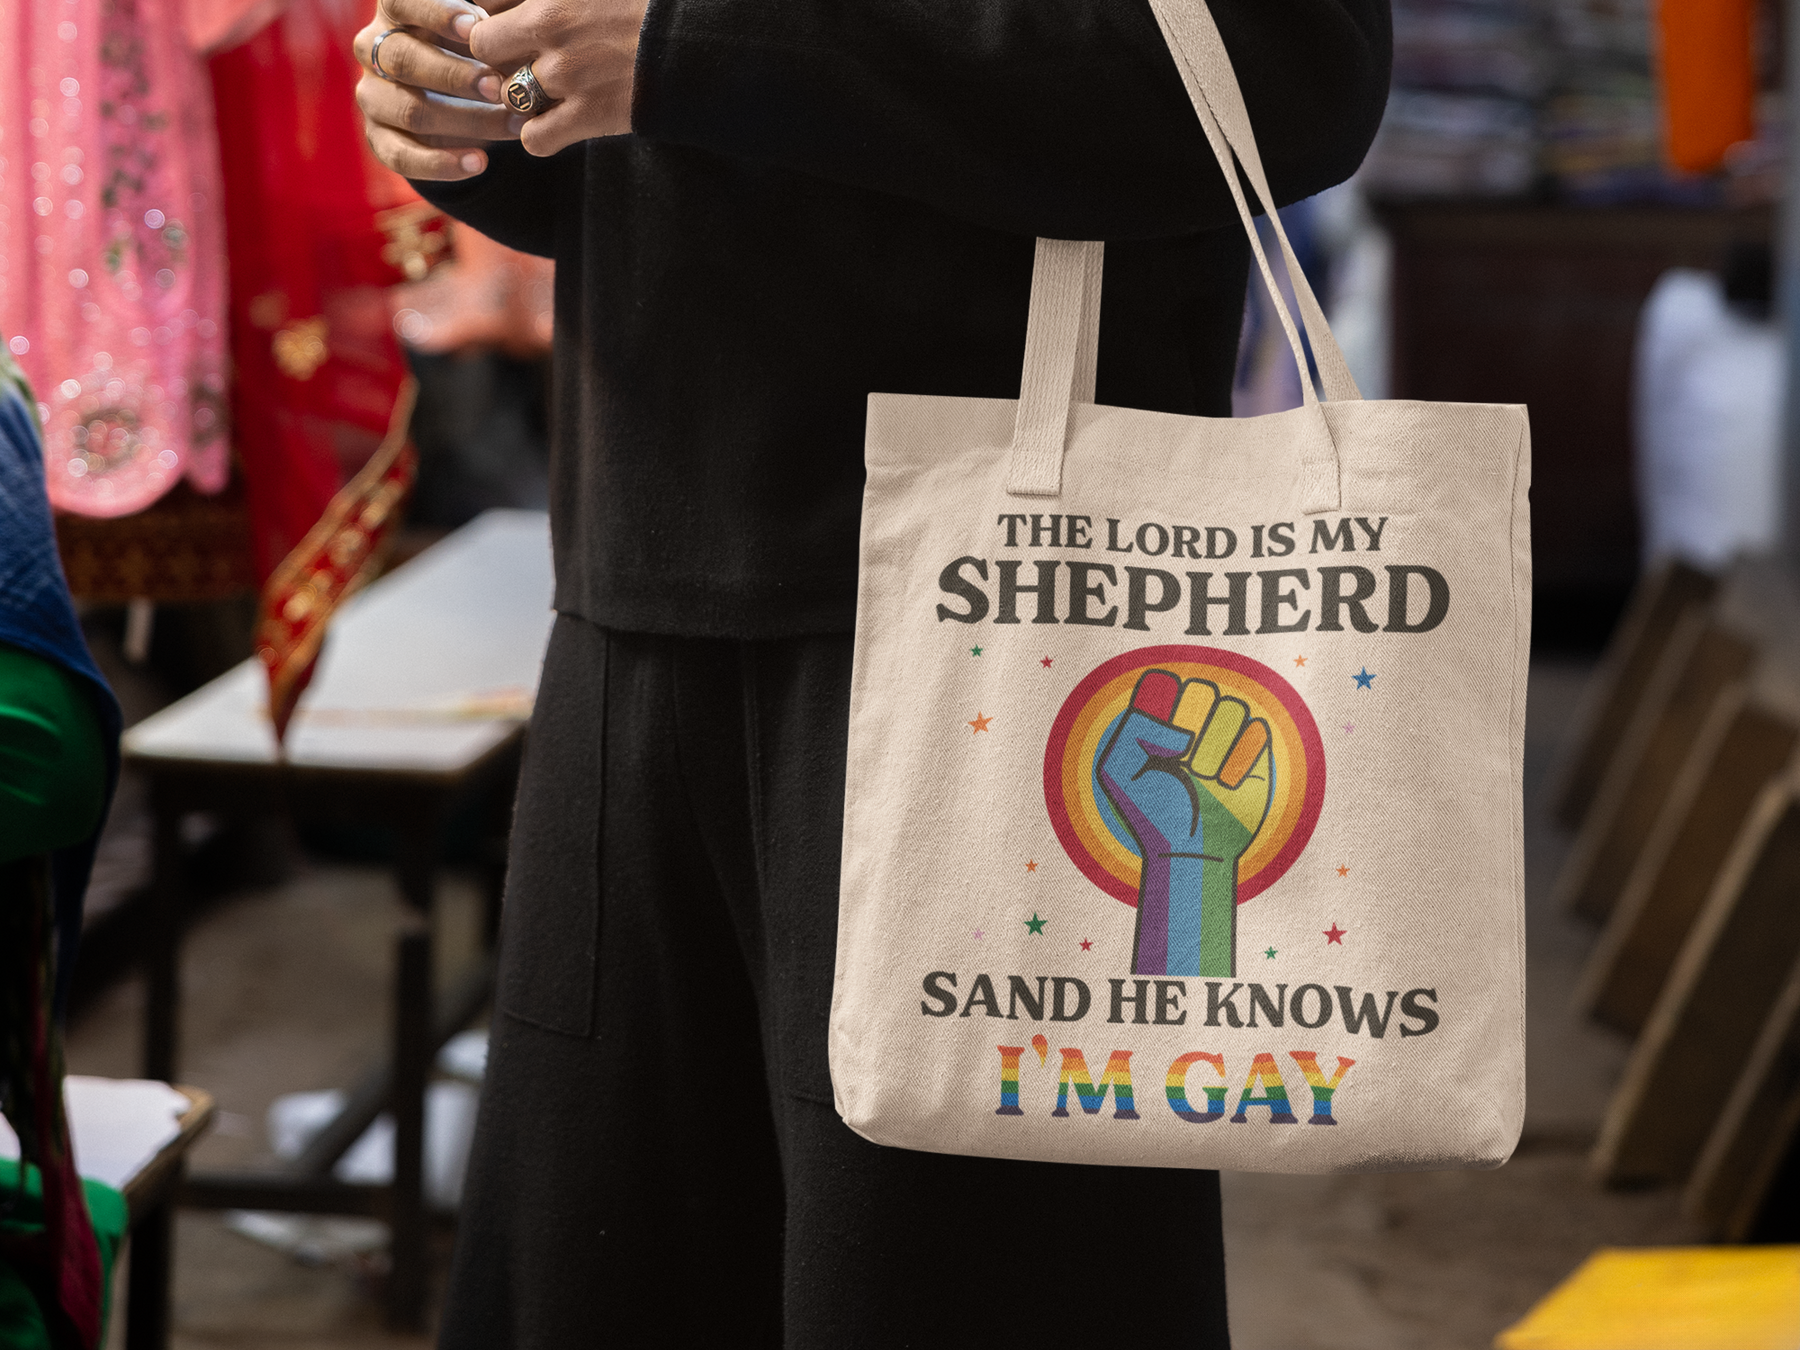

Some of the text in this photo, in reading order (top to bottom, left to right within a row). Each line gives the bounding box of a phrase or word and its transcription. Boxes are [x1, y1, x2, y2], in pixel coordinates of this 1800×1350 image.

[997, 513, 1389, 560] THE LORD IS MY
[935, 555, 1451, 637] SHEPHERD
[920, 970, 1441, 1040] SAND HE KNOWS
[995, 1033, 1357, 1127] I'M GAY
